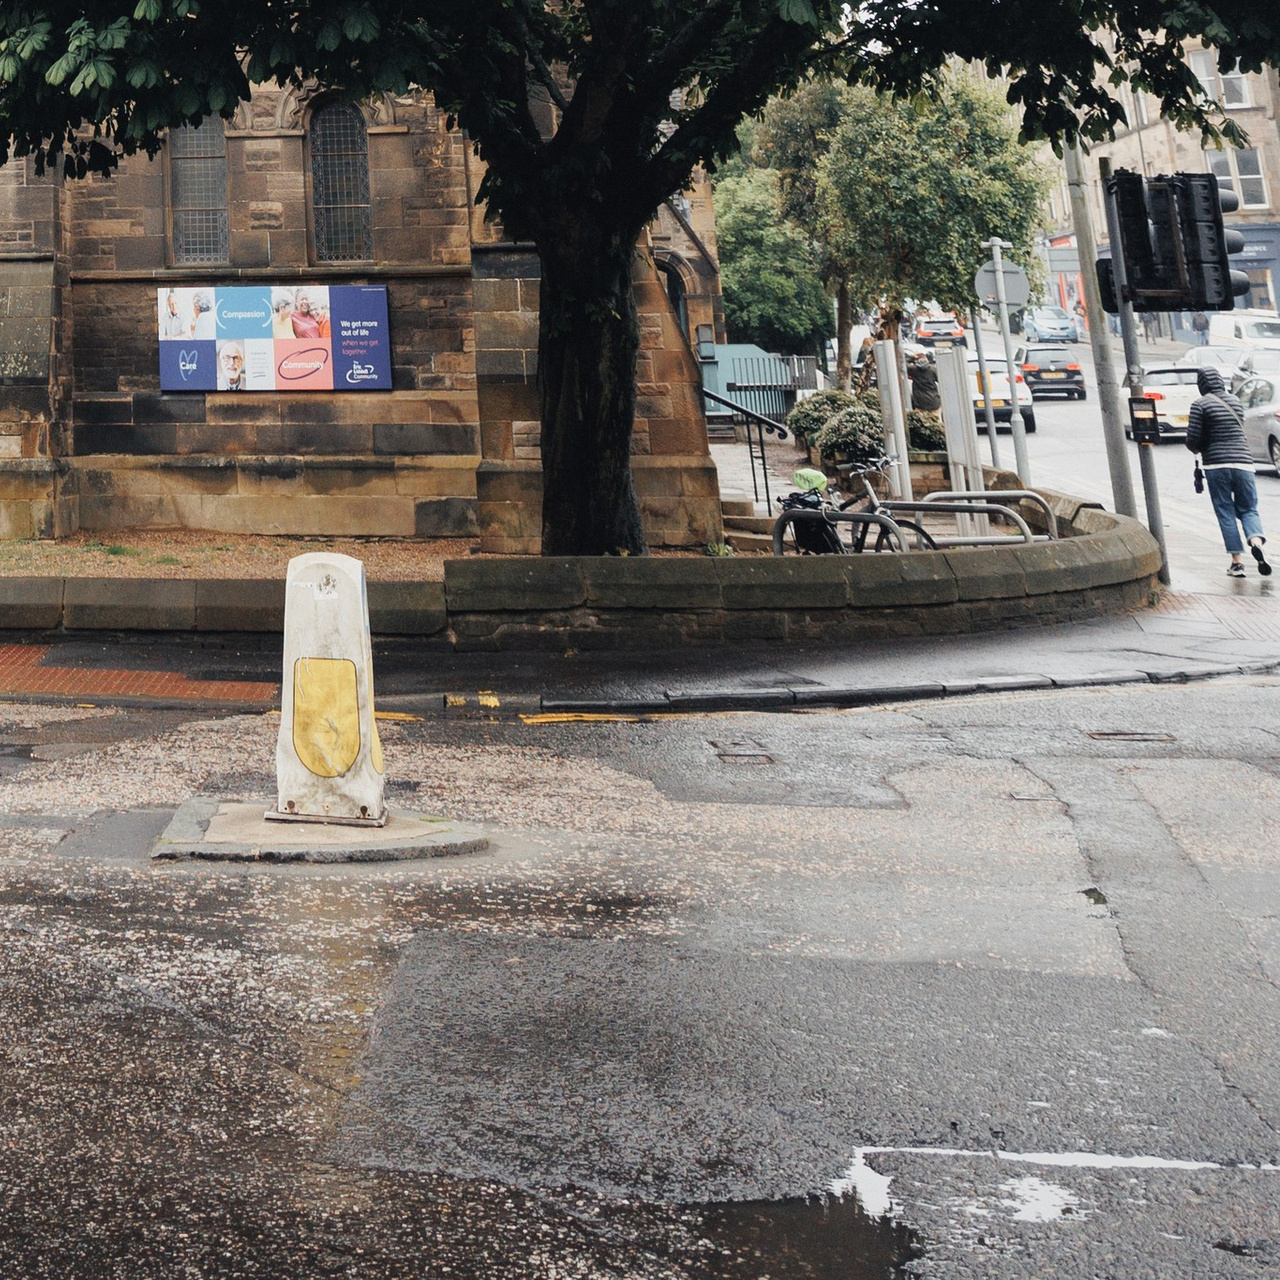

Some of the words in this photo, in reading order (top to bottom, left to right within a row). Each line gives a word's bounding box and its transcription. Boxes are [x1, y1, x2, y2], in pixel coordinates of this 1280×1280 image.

[222, 310, 265, 319] Compassion
[351, 321, 361, 329] get
[369, 340, 378, 348] get
[180, 362, 197, 370] Care
[283, 361, 324, 371] Community
